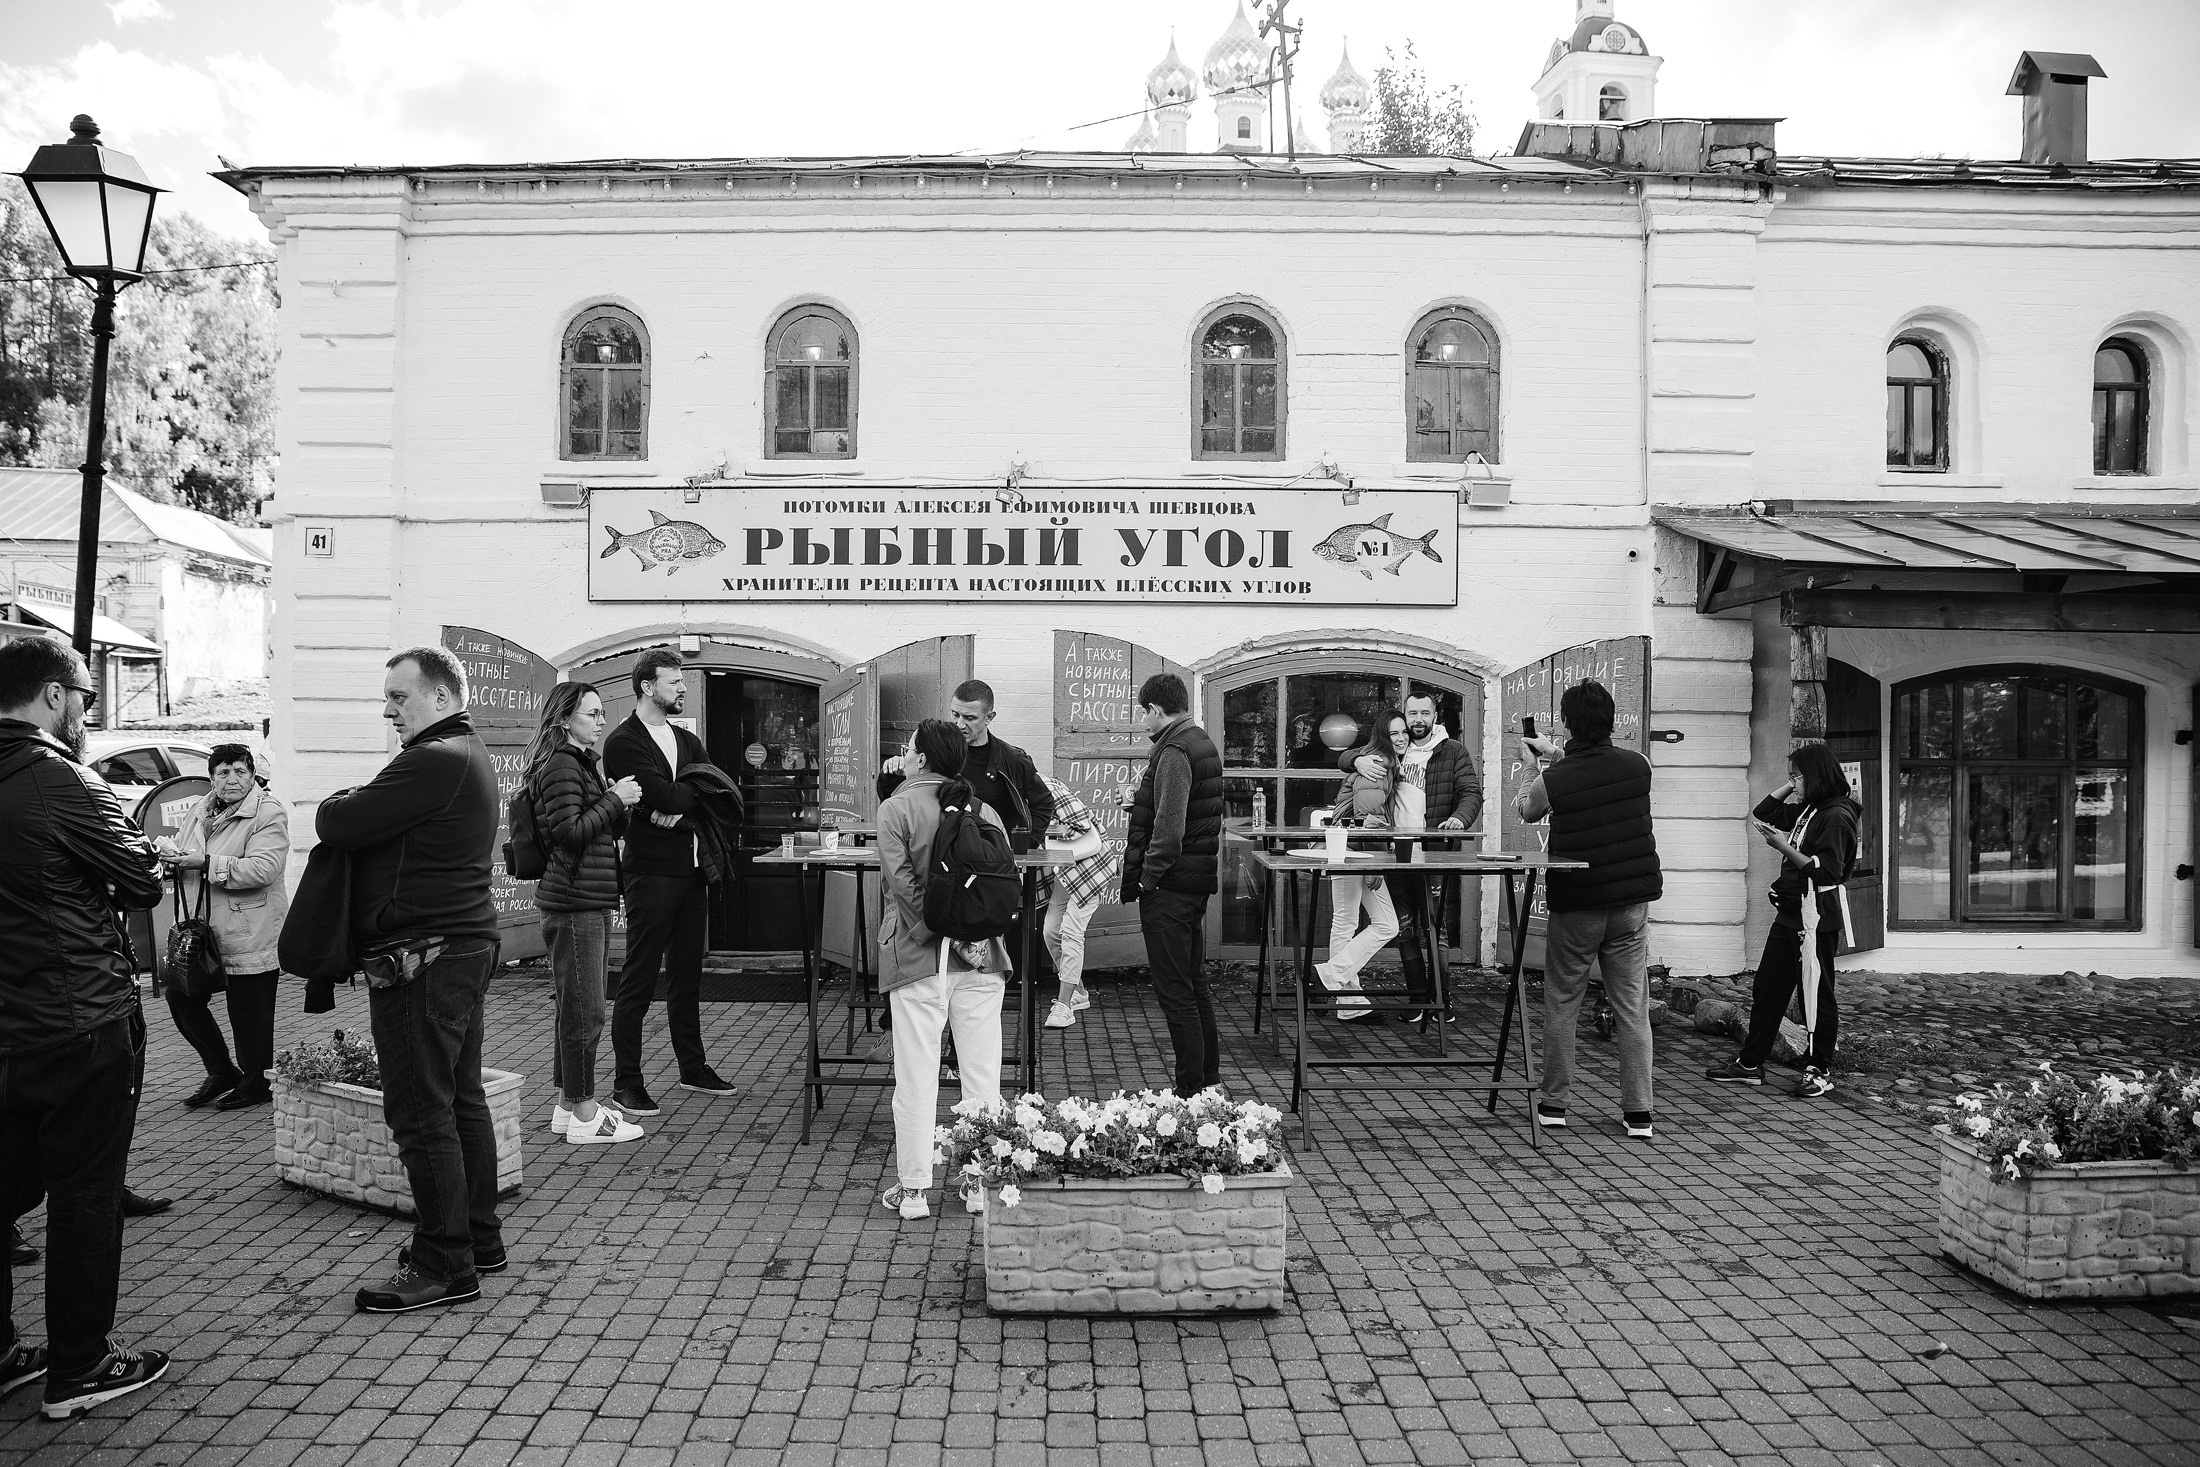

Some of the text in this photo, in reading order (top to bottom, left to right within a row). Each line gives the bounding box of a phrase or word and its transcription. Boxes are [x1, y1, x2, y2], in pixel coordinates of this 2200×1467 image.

[784, 500, 1256, 516] ПОТОМКИ АЛЕКСЕЯ ЕФИМОВИЧА ШЕВЦОВА
[311, 534, 327, 549] 41
[742, 516, 1293, 569] РЫБНЫЙ УГОЛ
[1357, 541, 1389, 556] №1
[722, 576, 1312, 594] ХРАНИТЕЛИ РЕЦЕПТА НАСТОЯЩИХ ПЛЁССКИХ УГЛОВ
[455, 634, 465, 652] А
[467, 642, 491, 653] ТАКЖЕ
[1064, 641, 1124, 662] А ТАКЖЕ
[1507, 657, 1624, 697] НАСТОЯЩИЕ
[468, 684, 543, 711] АССТЕГАИ
[1068, 682, 1139, 700] СЫТНЫЕ
[1070, 700, 1147, 722] РАССТЕГ
[831, 709, 851, 738] УГЛЫ
[489, 753, 525, 773] РОЖК
[1069, 761, 1149, 784] ПИРОЖ
[490, 887, 517, 899] РОЕКТ
